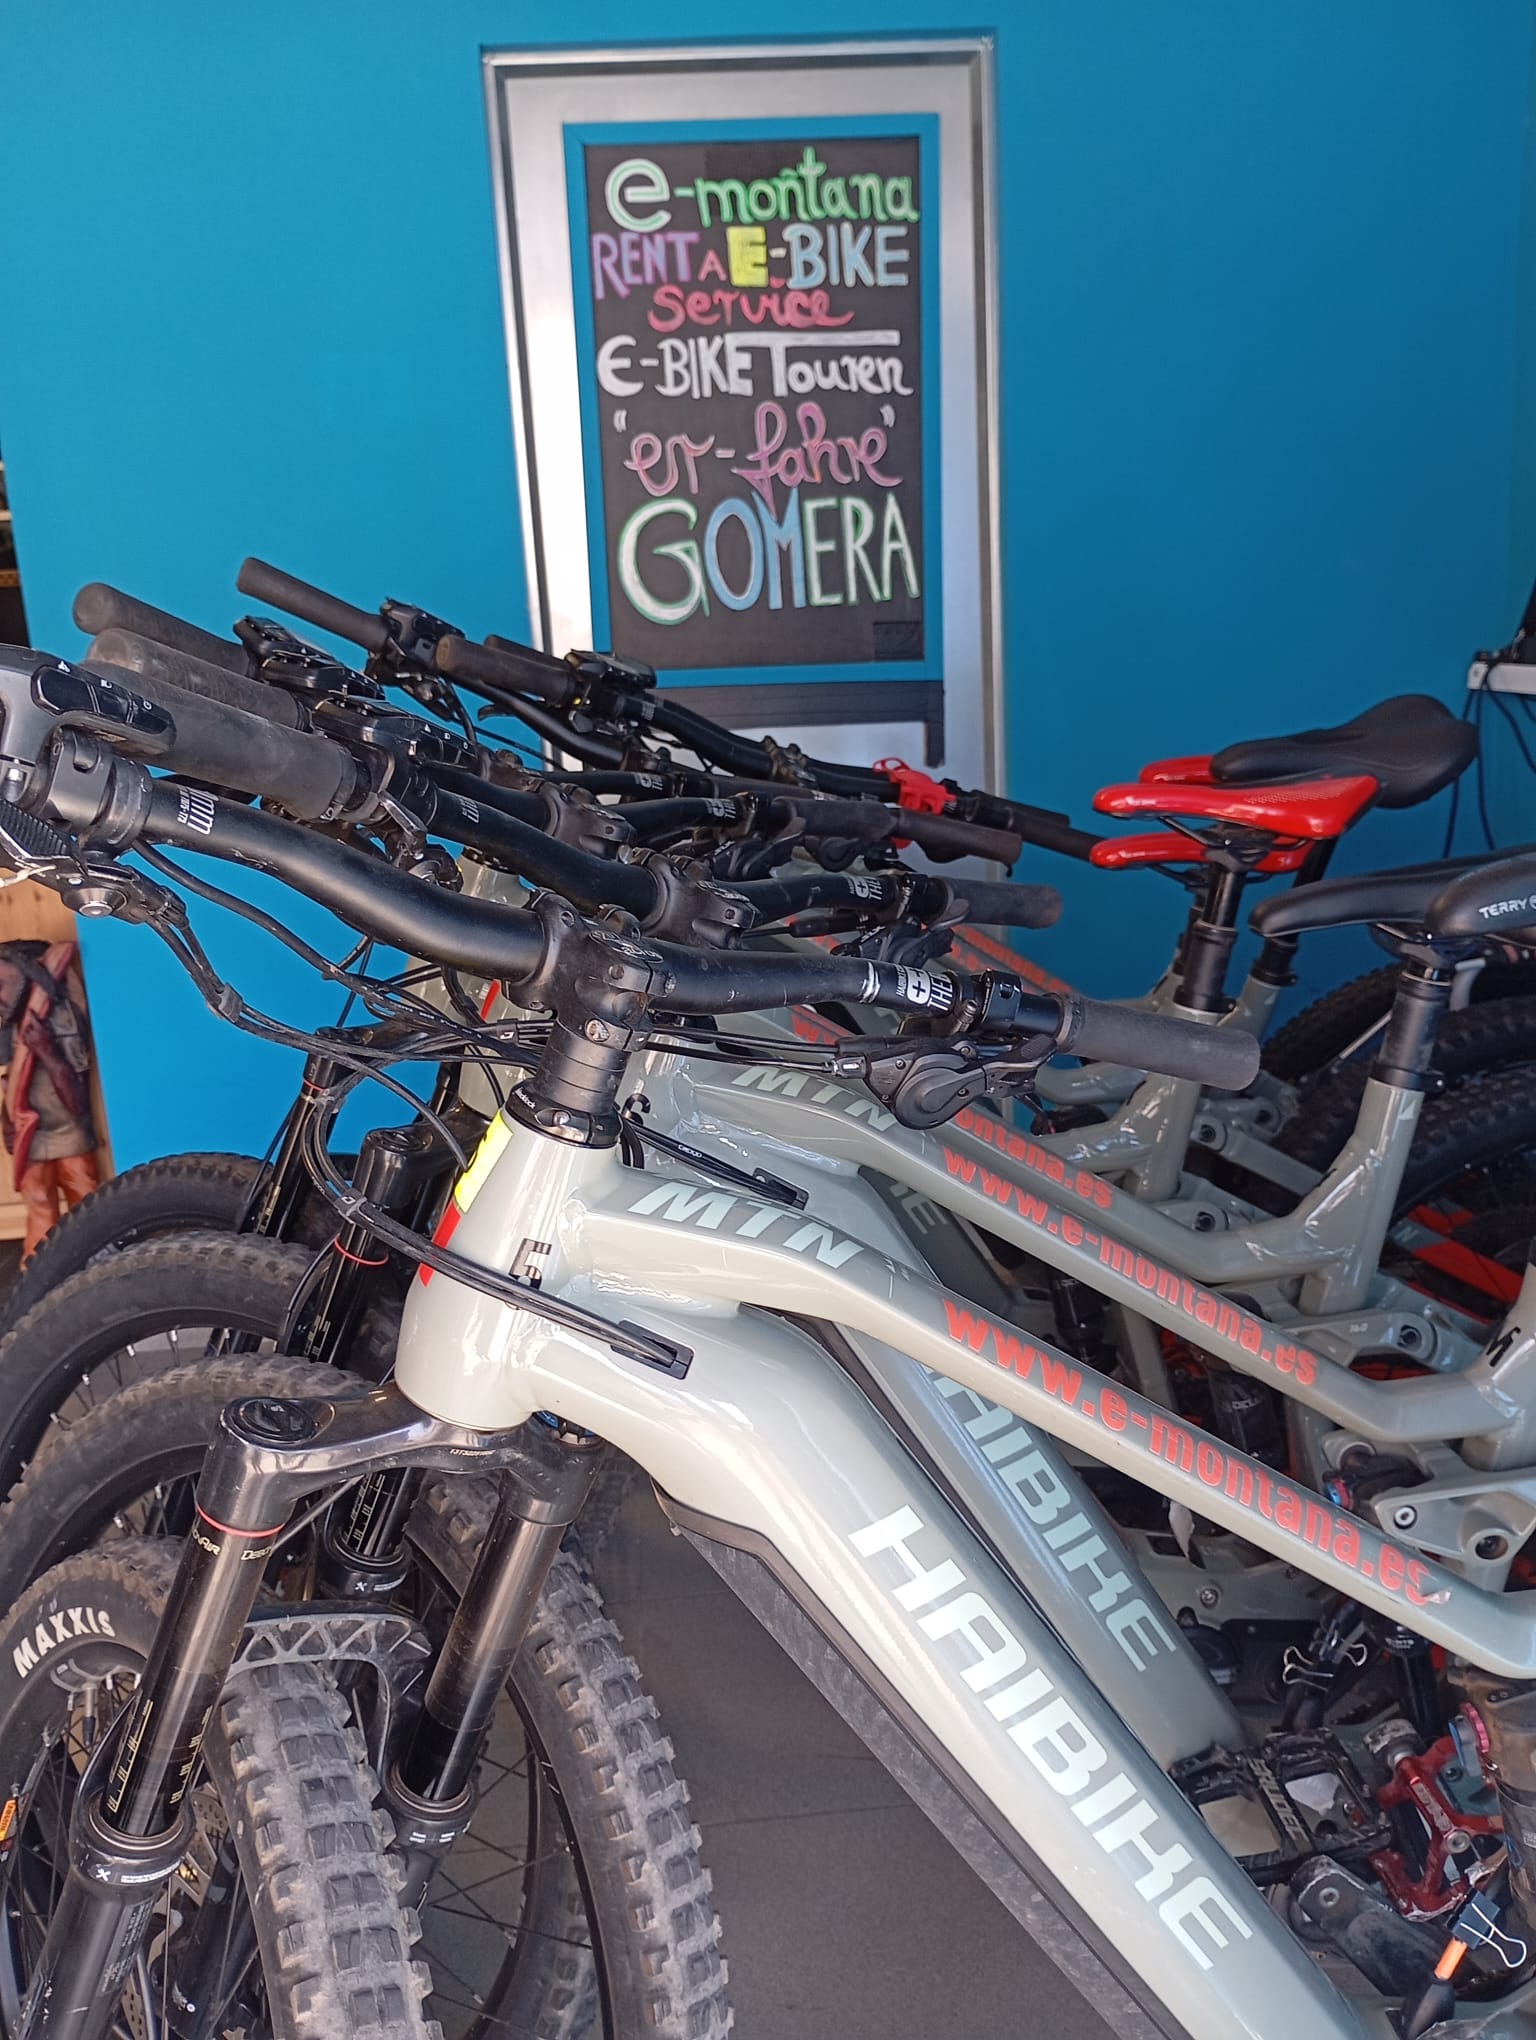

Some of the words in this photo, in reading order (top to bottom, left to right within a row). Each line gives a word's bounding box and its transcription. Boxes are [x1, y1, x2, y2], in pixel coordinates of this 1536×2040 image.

[592, 231, 699, 299] RENT
[697, 250, 727, 282] A
[726, 223, 910, 289] E-BIKE
[646, 274, 855, 333] Service
[597, 334, 753, 399] E-BIKE
[722, 331, 914, 398] Touren
[618, 486, 921, 625] GOMERA
[1478, 898, 1528, 919] TERRY
[730, 1065, 898, 1132] MTN
[628, 1182, 864, 1270] MTN
[942, 1144, 1318, 1385] www.e-montana.es
[942, 1298, 1434, 1607] www.e-montana.es
[920, 1364, 1177, 1673] AIBIKE
[12, 1606, 116, 1679] MAXXIS
[848, 1504, 1254, 1971] HAIBIKE
